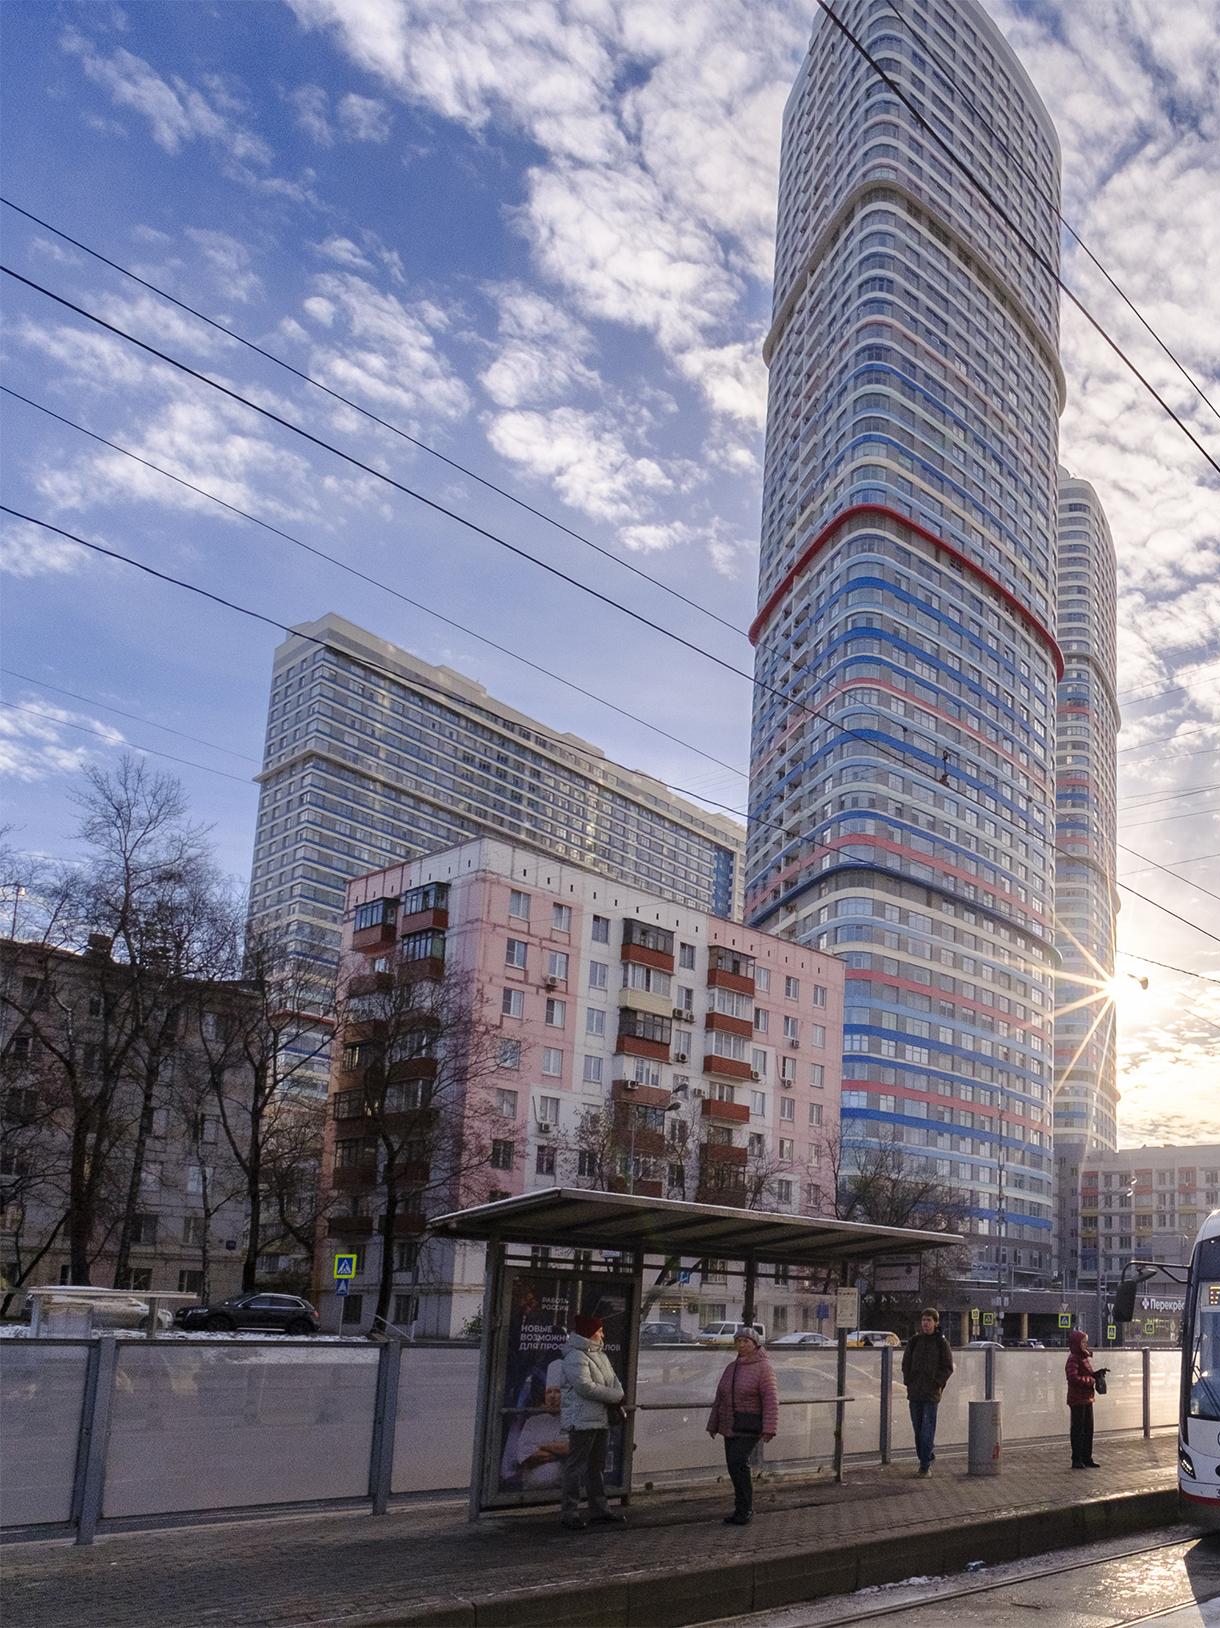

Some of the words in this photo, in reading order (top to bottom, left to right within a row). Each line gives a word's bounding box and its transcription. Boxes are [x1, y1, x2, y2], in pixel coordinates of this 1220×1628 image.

[521, 1325, 553, 1333] НОВЫЕ
[520, 1334, 566, 1342] ВОЗМОЖН
[518, 1343, 539, 1351] ДЛЯ
